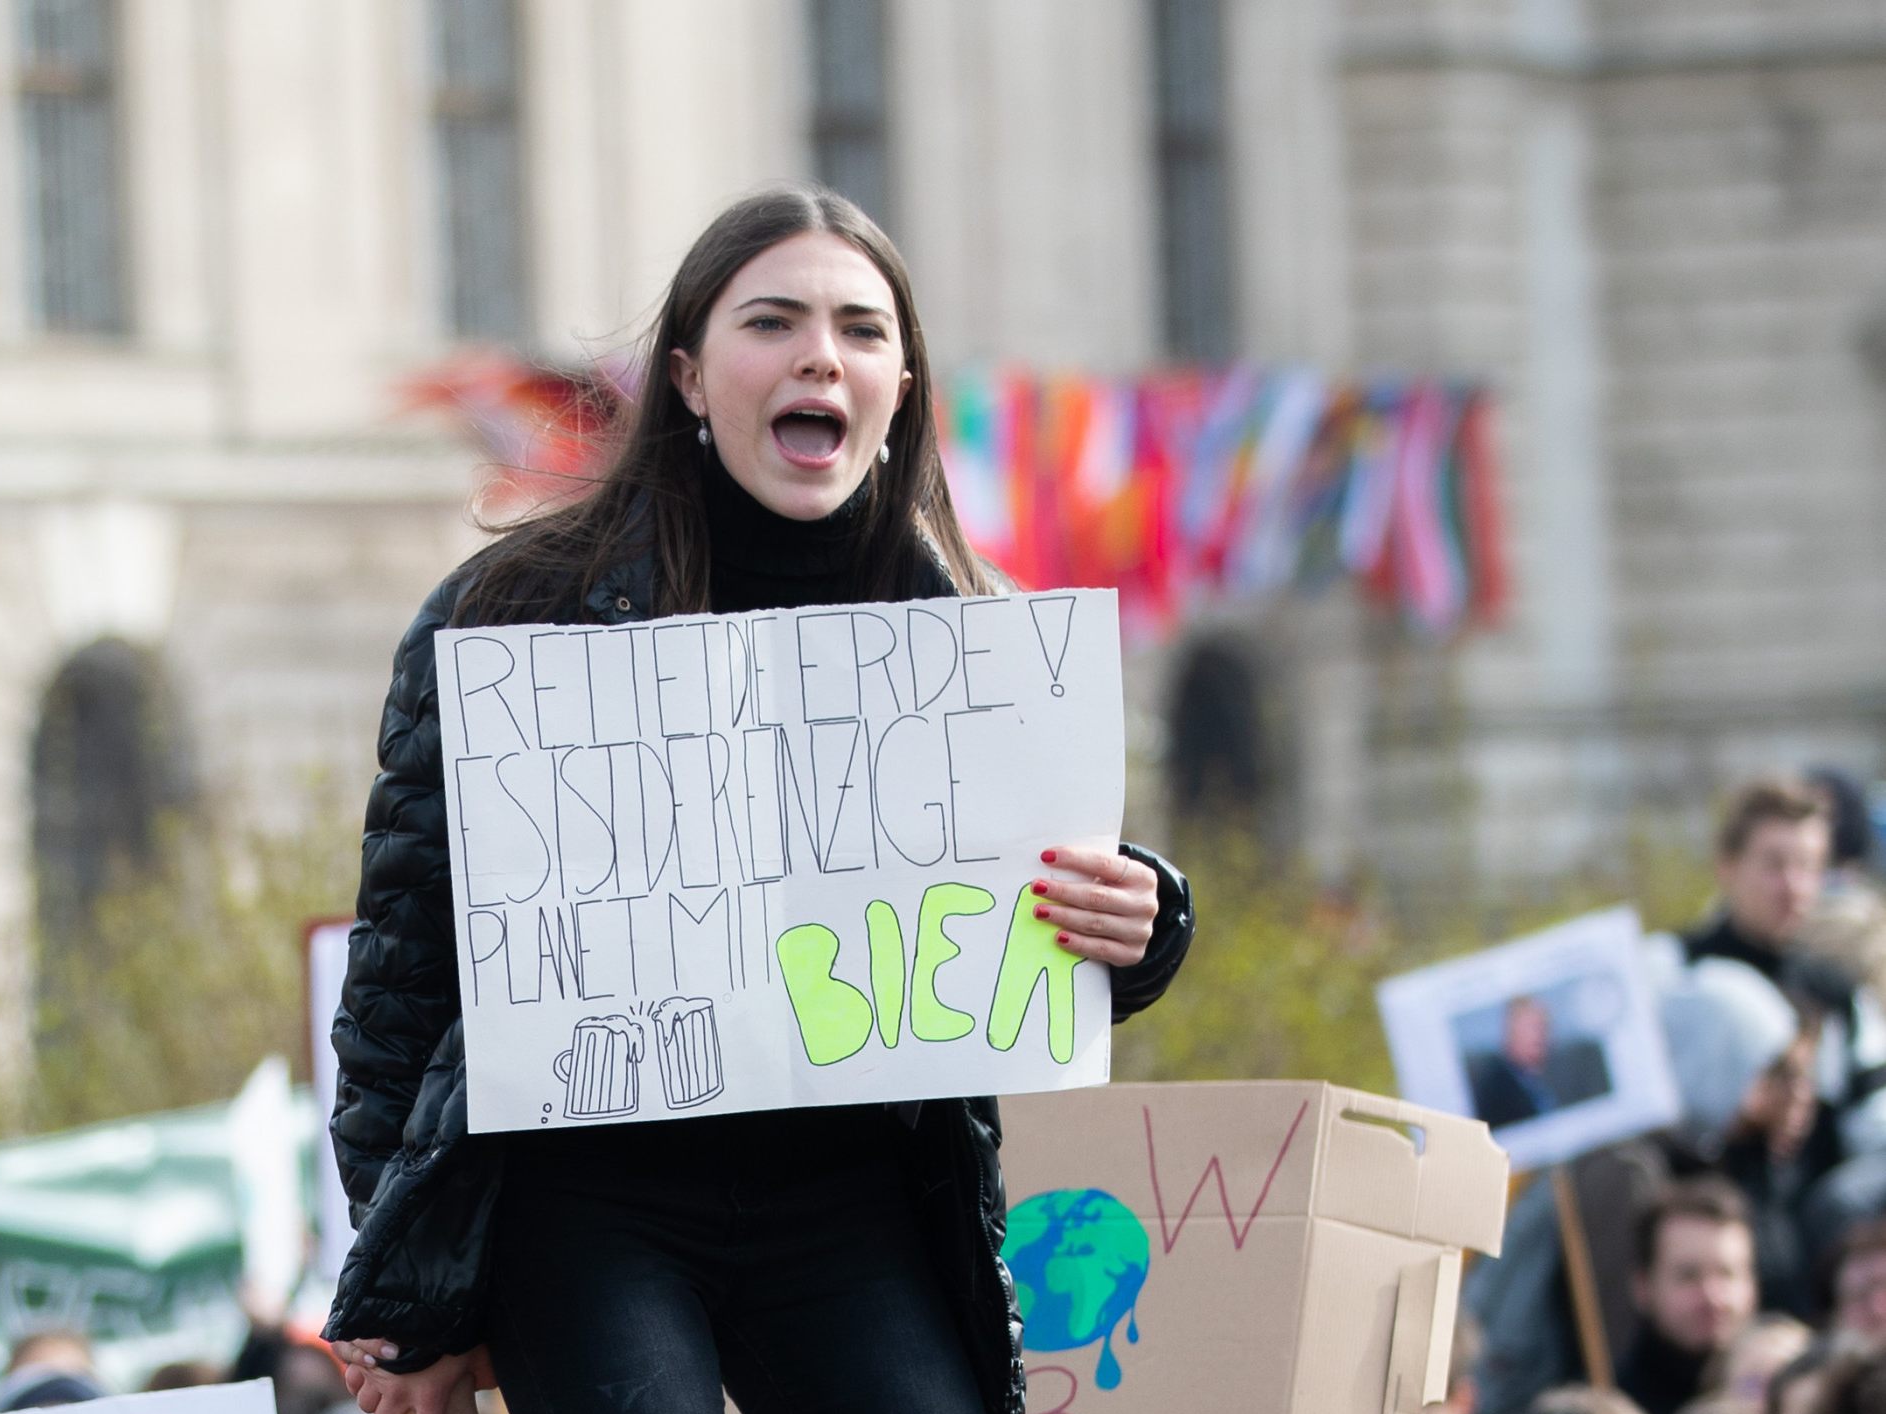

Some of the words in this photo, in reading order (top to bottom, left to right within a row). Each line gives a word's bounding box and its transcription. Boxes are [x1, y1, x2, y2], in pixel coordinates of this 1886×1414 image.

[454, 620, 720, 756] RETTET
[725, 615, 784, 729] DIE
[455, 752, 551, 908] ES
[551, 740, 636, 898] IST
[636, 730, 746, 893] DER
[742, 708, 1002, 882] EINZIGE
[466, 891, 648, 1006] PLANET
[668, 879, 782, 992] MIT
[776, 882, 1089, 1066] BIER
